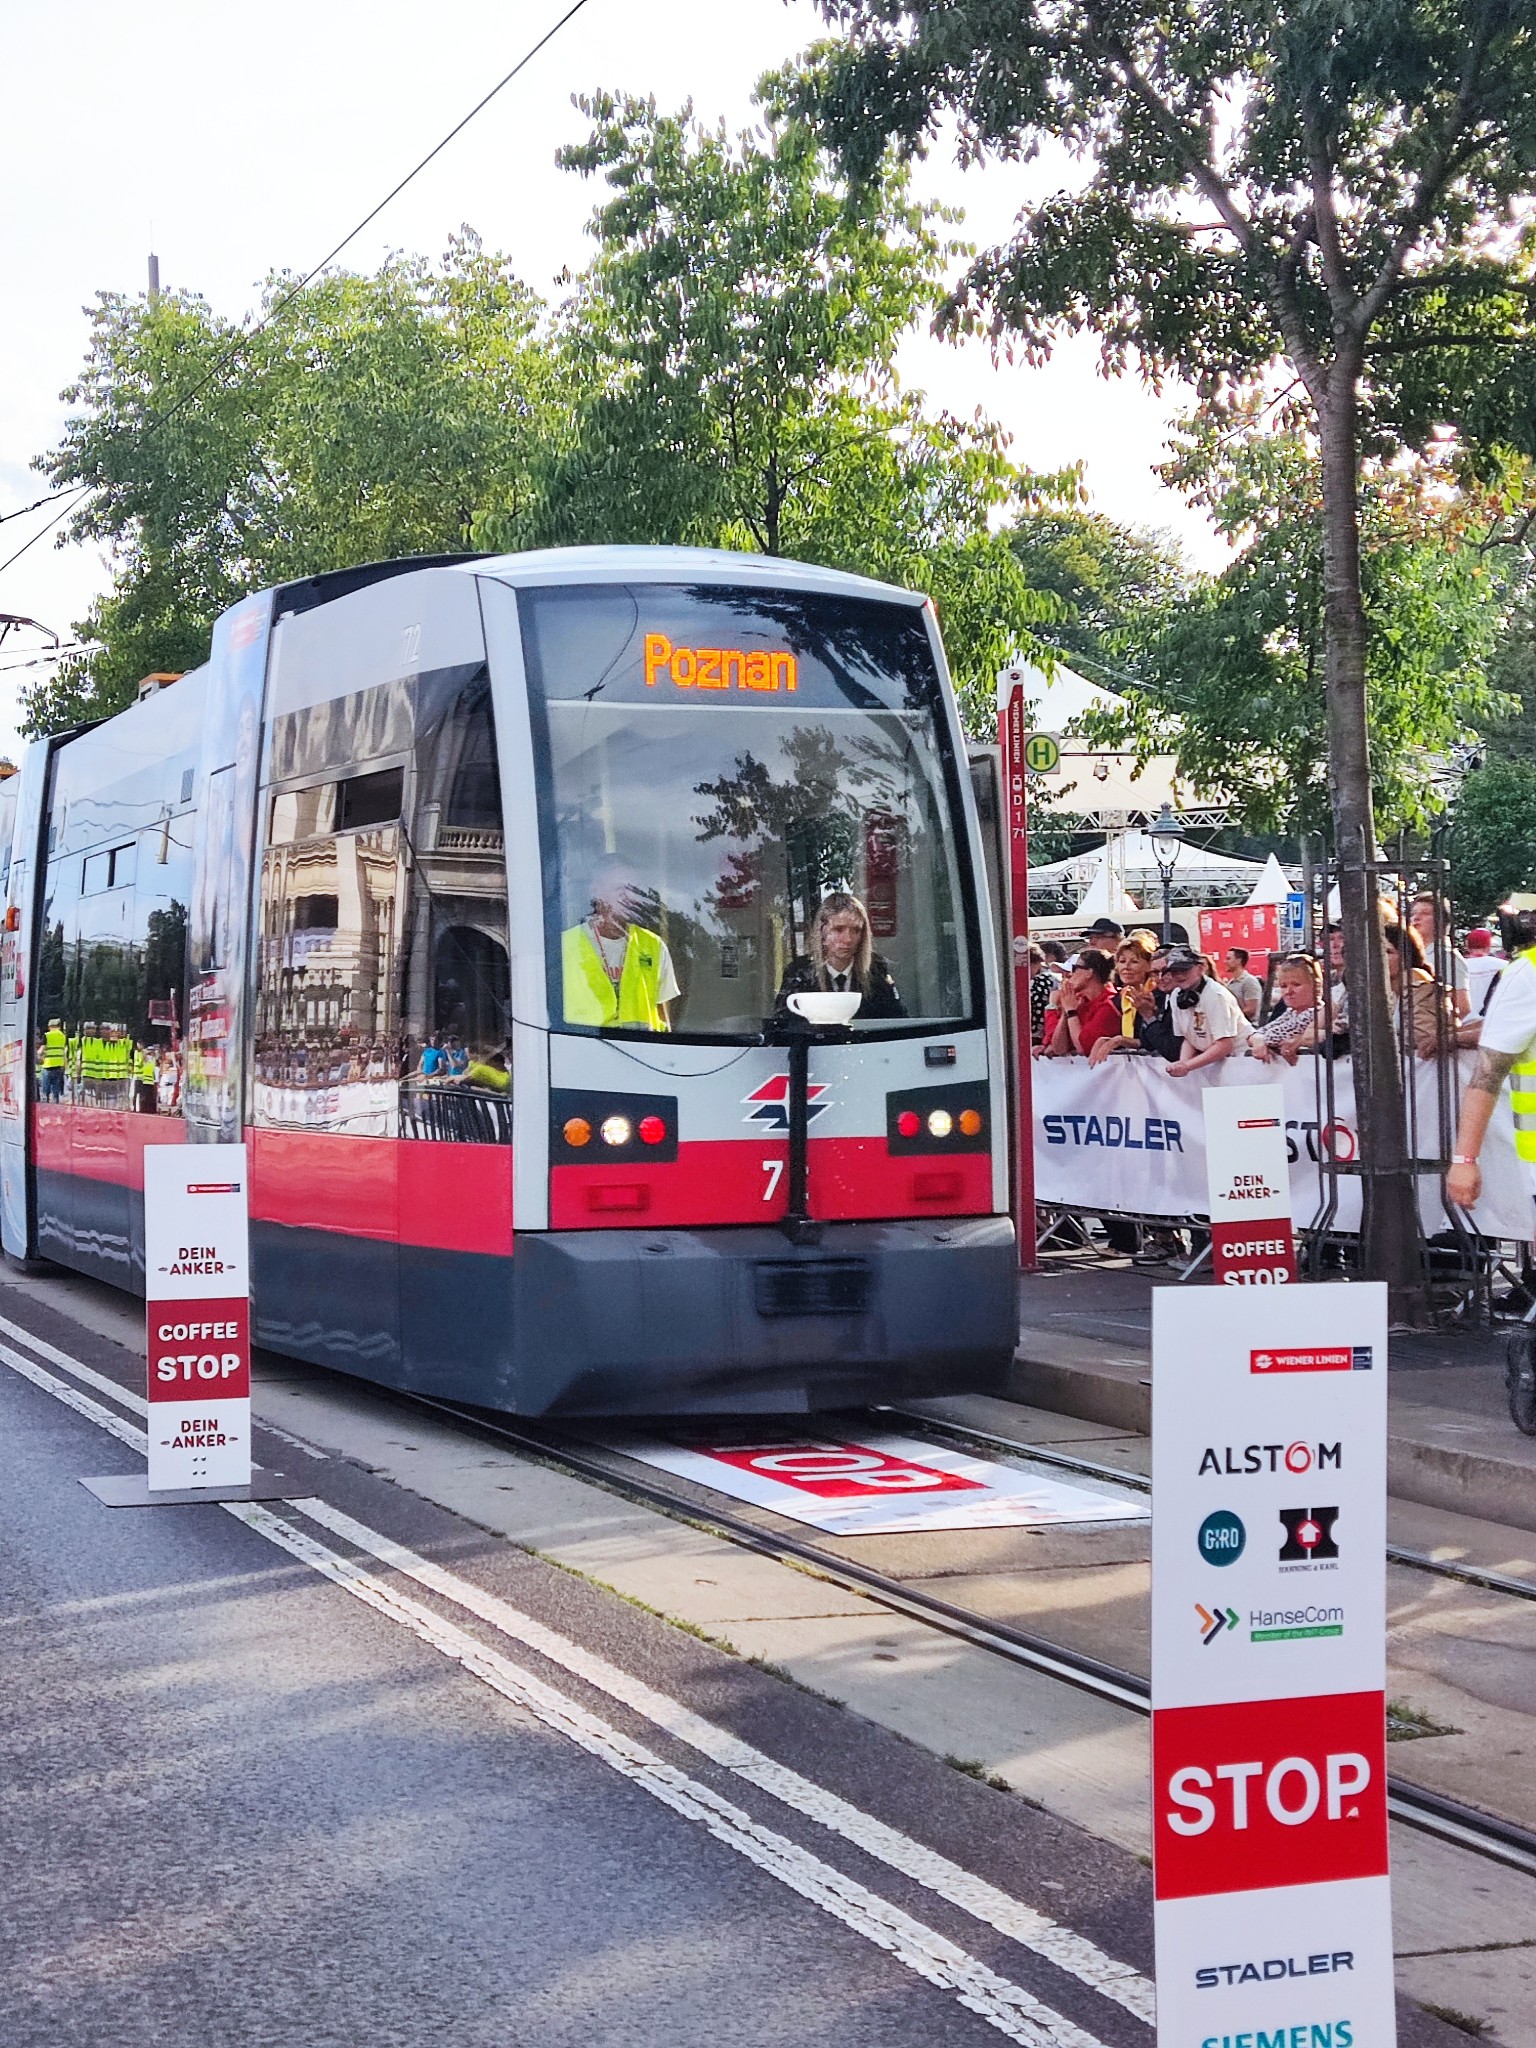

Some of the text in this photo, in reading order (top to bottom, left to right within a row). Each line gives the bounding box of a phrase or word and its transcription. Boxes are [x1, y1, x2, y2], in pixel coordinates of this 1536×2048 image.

[645, 633, 798, 692] Poznan
[1013, 701, 1021, 763] WIENER LINIEN
[1033, 742, 1050, 765] H
[1014, 795, 1023, 806] D
[1015, 811, 1021, 822] 1
[1013, 827, 1024, 839] 71
[1043, 1114, 1184, 1153] STADLER
[1234, 1175, 1264, 1186] DEIN
[1228, 1187, 1271, 1200] ANKER
[178, 1247, 216, 1260] DEIN
[1222, 1239, 1285, 1258] COFFEE
[170, 1262, 224, 1276] ANKER
[1223, 1267, 1289, 1286] STOP
[158, 1322, 238, 1342] COFFEE
[157, 1354, 241, 1382] STOP
[1275, 1356, 1314, 1366] WIENER
[1316, 1354, 1348, 1365] LINIEN
[181, 1419, 218, 1432] DEIN
[172, 1434, 226, 1448] ANKER
[706, 1435, 944, 1488] TOP
[1198, 1440, 1342, 1476] ALSTOM
[1205, 1528, 1239, 1550] GIRO
[1250, 1606, 1344, 1626] HanseCom
[1167, 1752, 1371, 1836] STOP
[1195, 1951, 1354, 1988] STADLER
